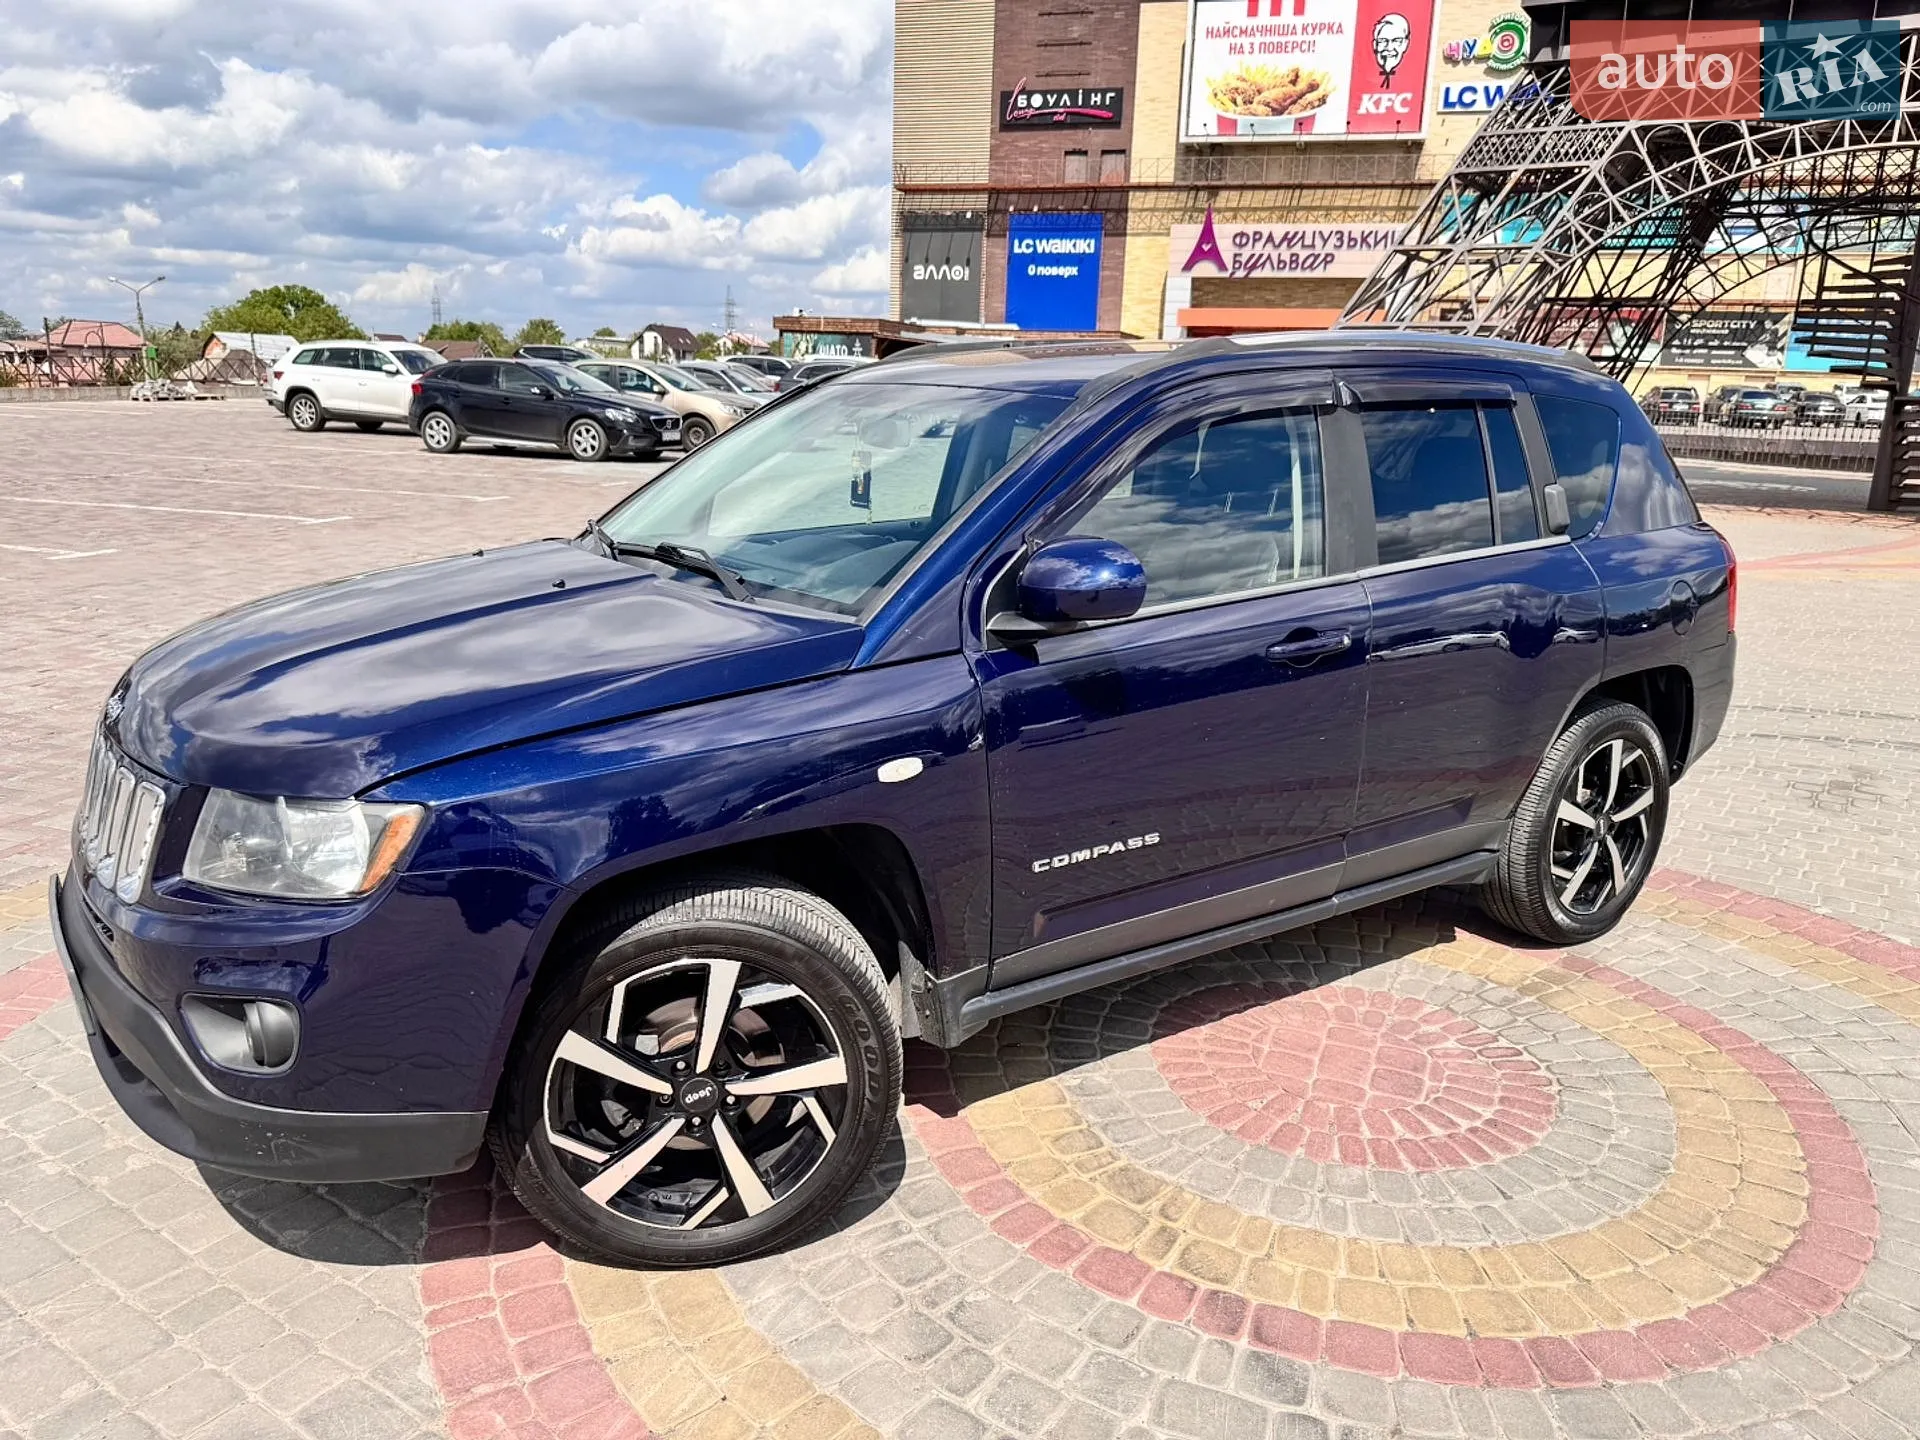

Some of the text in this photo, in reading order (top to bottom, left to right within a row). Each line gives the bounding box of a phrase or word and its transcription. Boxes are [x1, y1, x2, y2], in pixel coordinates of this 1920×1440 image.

[1206, 22, 1344, 39] НАЙСМАЧНІША КУРКА
[1229, 40, 1316, 56] НА 3 ПОВЕРСІ!
[1017, 89, 1116, 108] БОУЛІНГ
[1357, 93, 1412, 114] KFC
[1443, 85, 1478, 109] LC
[1014, 239, 1034, 253] LC
[1037, 265, 1078, 277] поверх
[1691, 319, 1757, 329] SPORTCITY
[1031, 832, 1161, 873] COMPASS
[685, 1086, 712, 1104] Jeep
